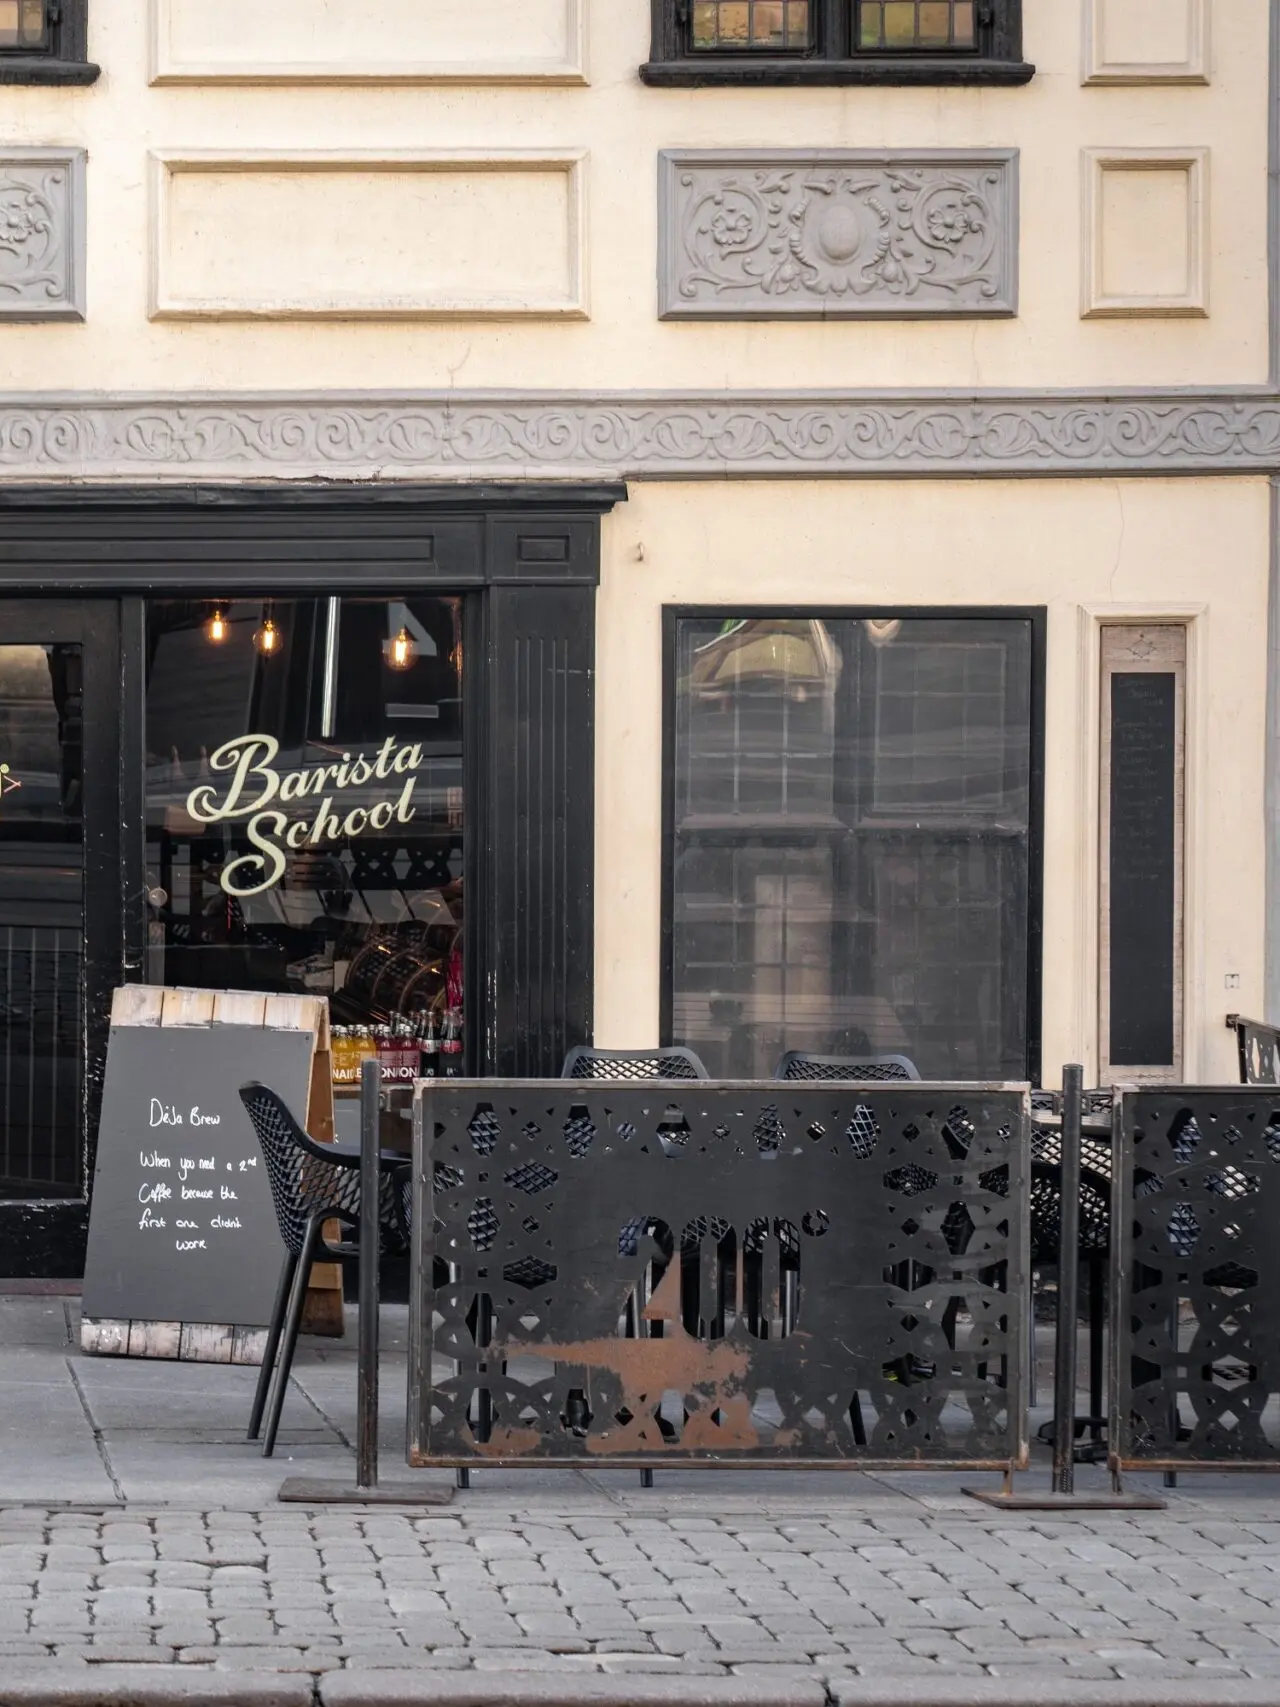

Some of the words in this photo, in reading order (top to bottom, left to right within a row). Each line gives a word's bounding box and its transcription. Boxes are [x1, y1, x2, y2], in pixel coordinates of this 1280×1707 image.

[186, 733, 424, 823] Barista
[220, 776, 418, 897] School
[190, 1106, 220, 1126] Brew
[140, 1150, 171, 1168] When
[178, 1157, 195, 1181] you
[199, 1156, 215, 1170] need
[226, 1162, 233, 1172] a
[138, 1183, 172, 1203] Coffee
[181, 1185, 214, 1200] because
[220, 1185, 238, 1200] the
[138, 1208, 167, 1230] first
[176, 1220, 199, 1229] one
[176, 1240, 207, 1251] work
